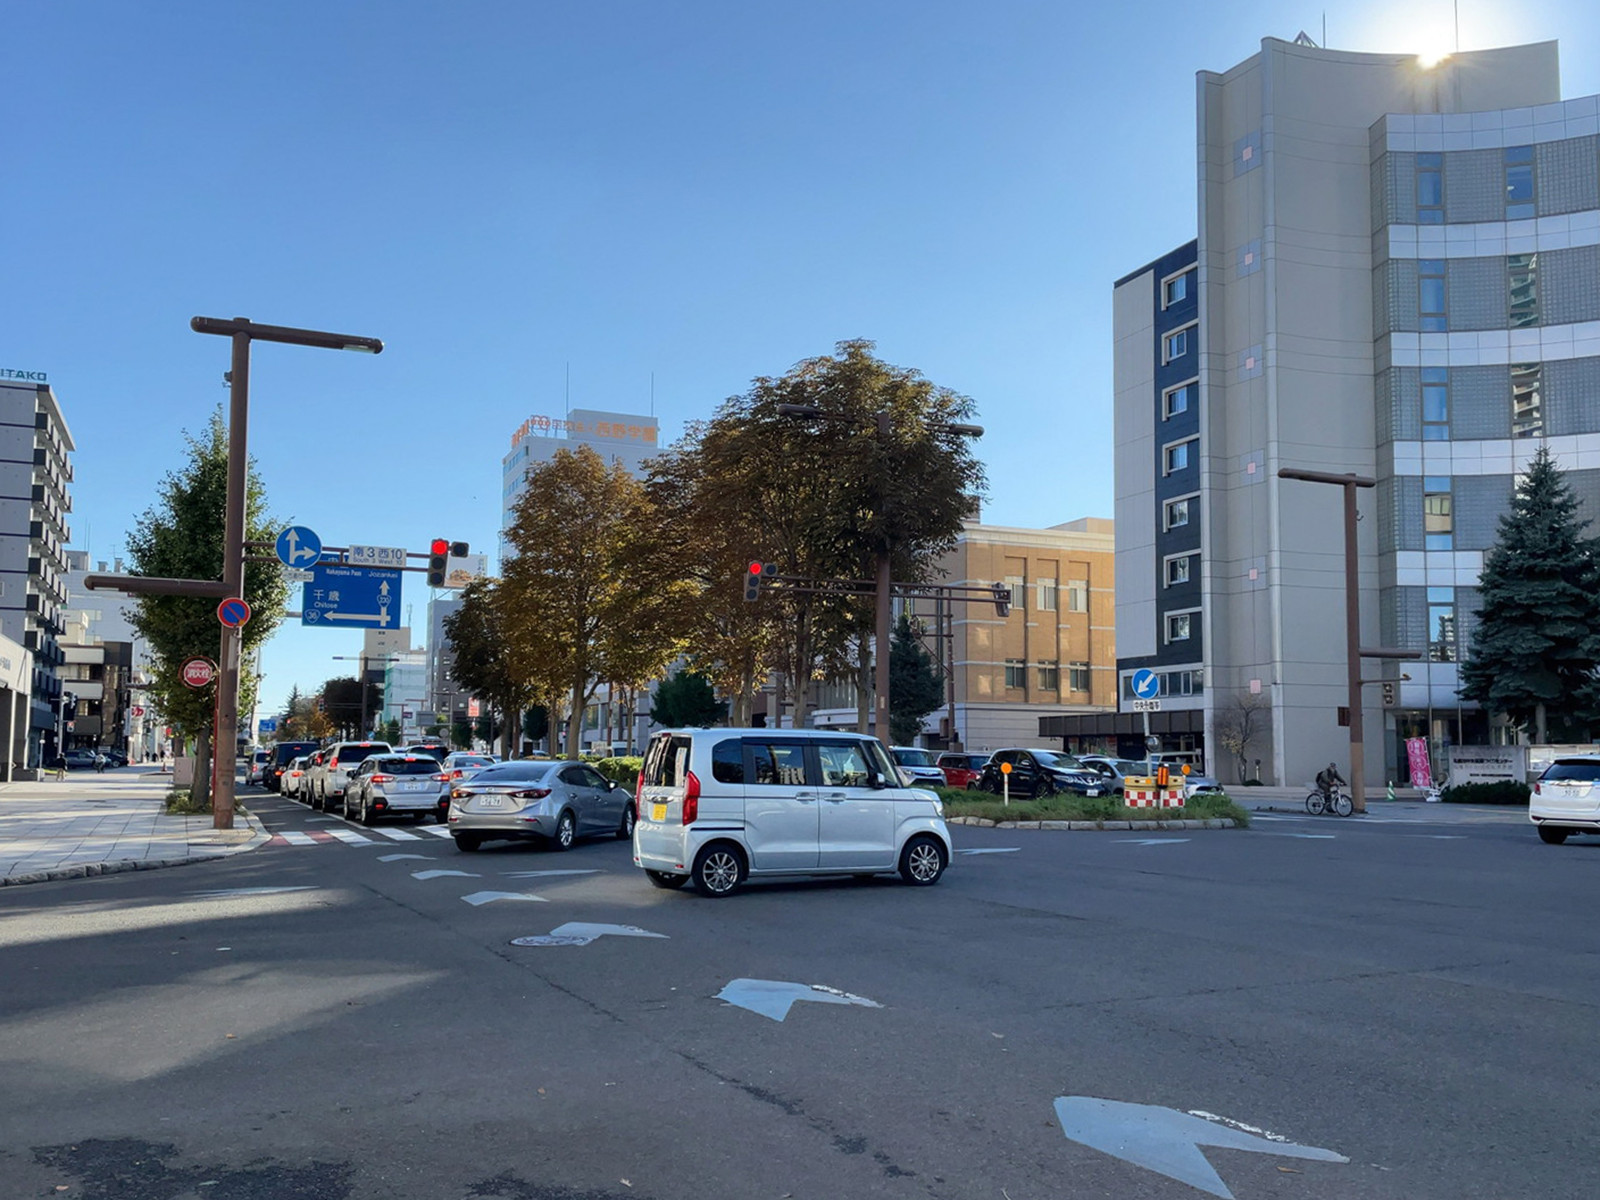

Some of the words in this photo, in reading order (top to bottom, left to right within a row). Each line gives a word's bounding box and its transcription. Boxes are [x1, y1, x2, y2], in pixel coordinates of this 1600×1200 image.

[313, 589, 340, 602] 千歳
[314, 601, 338, 609] Chitose
[187, 668, 210, 679] 消火栓
